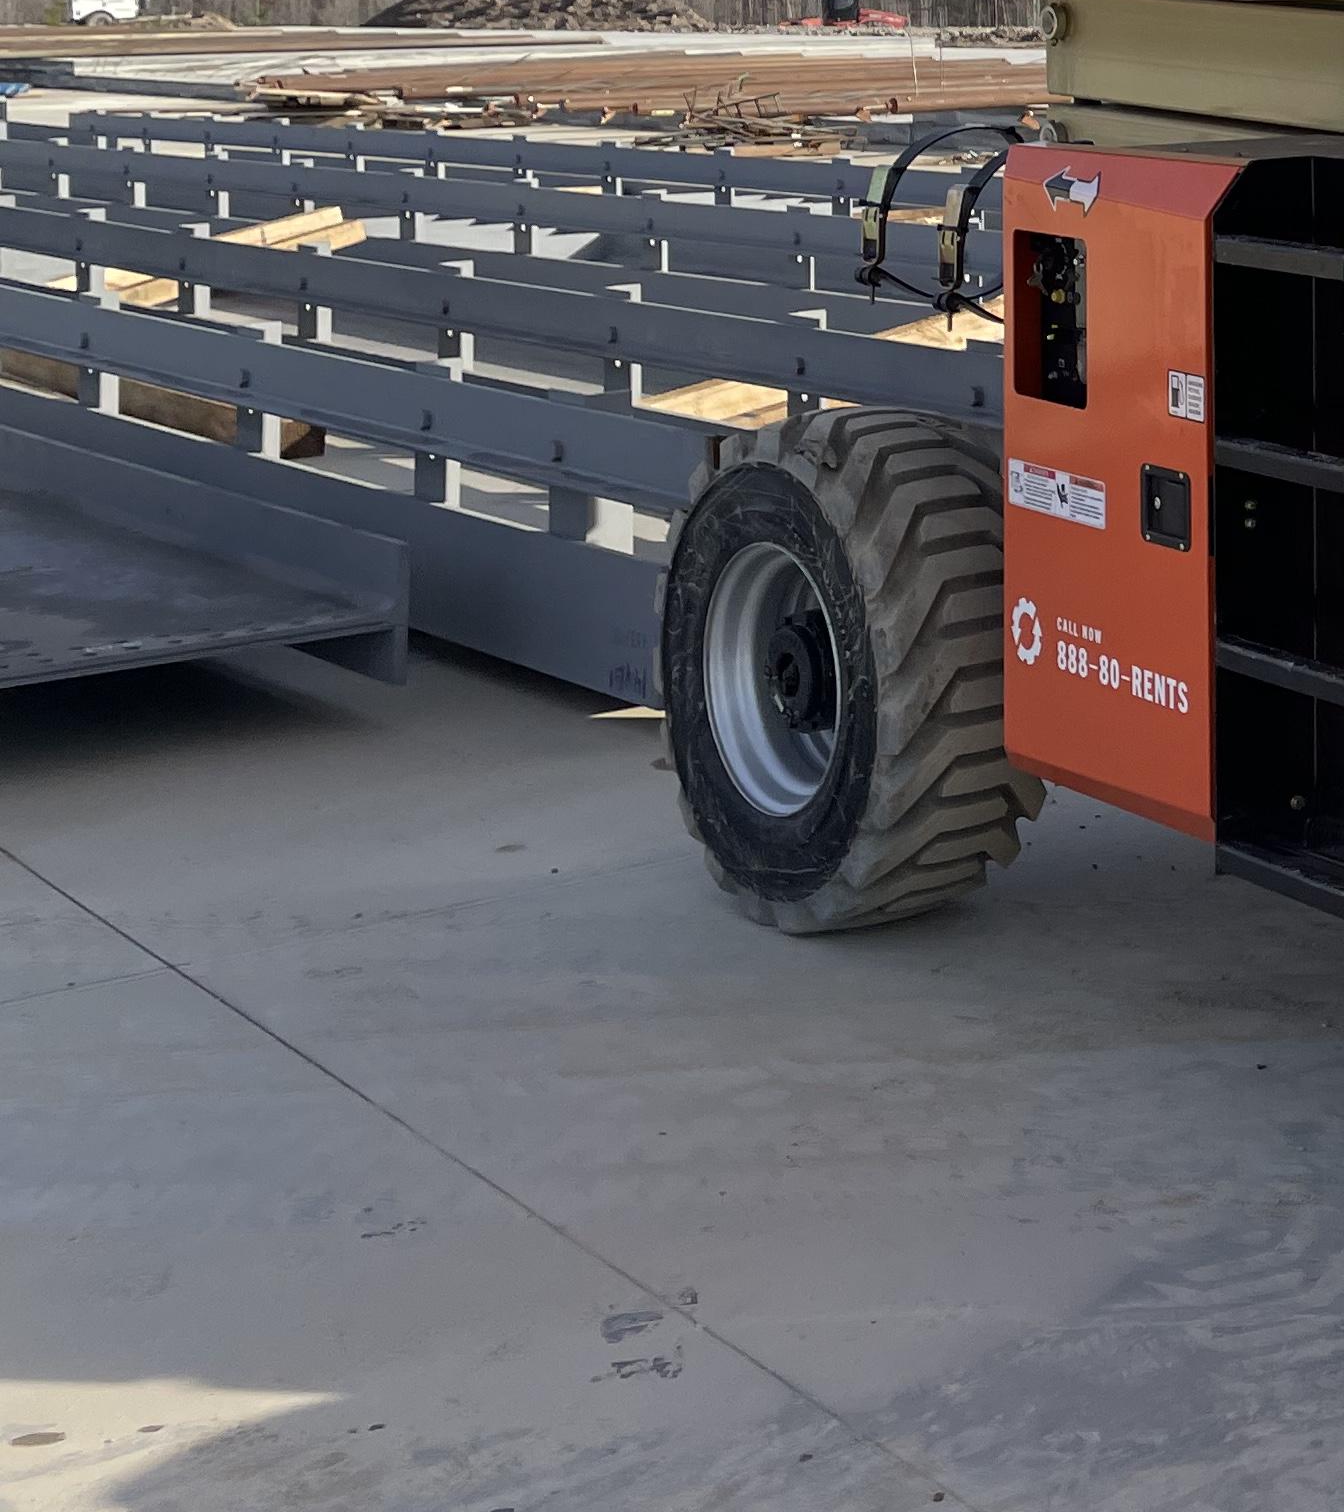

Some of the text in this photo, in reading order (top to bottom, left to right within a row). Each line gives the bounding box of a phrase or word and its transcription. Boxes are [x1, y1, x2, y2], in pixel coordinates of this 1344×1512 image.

[1056, 616, 1103, 645] CALL NOW
[1056, 640, 1189, 714] 888-80-RENTS
